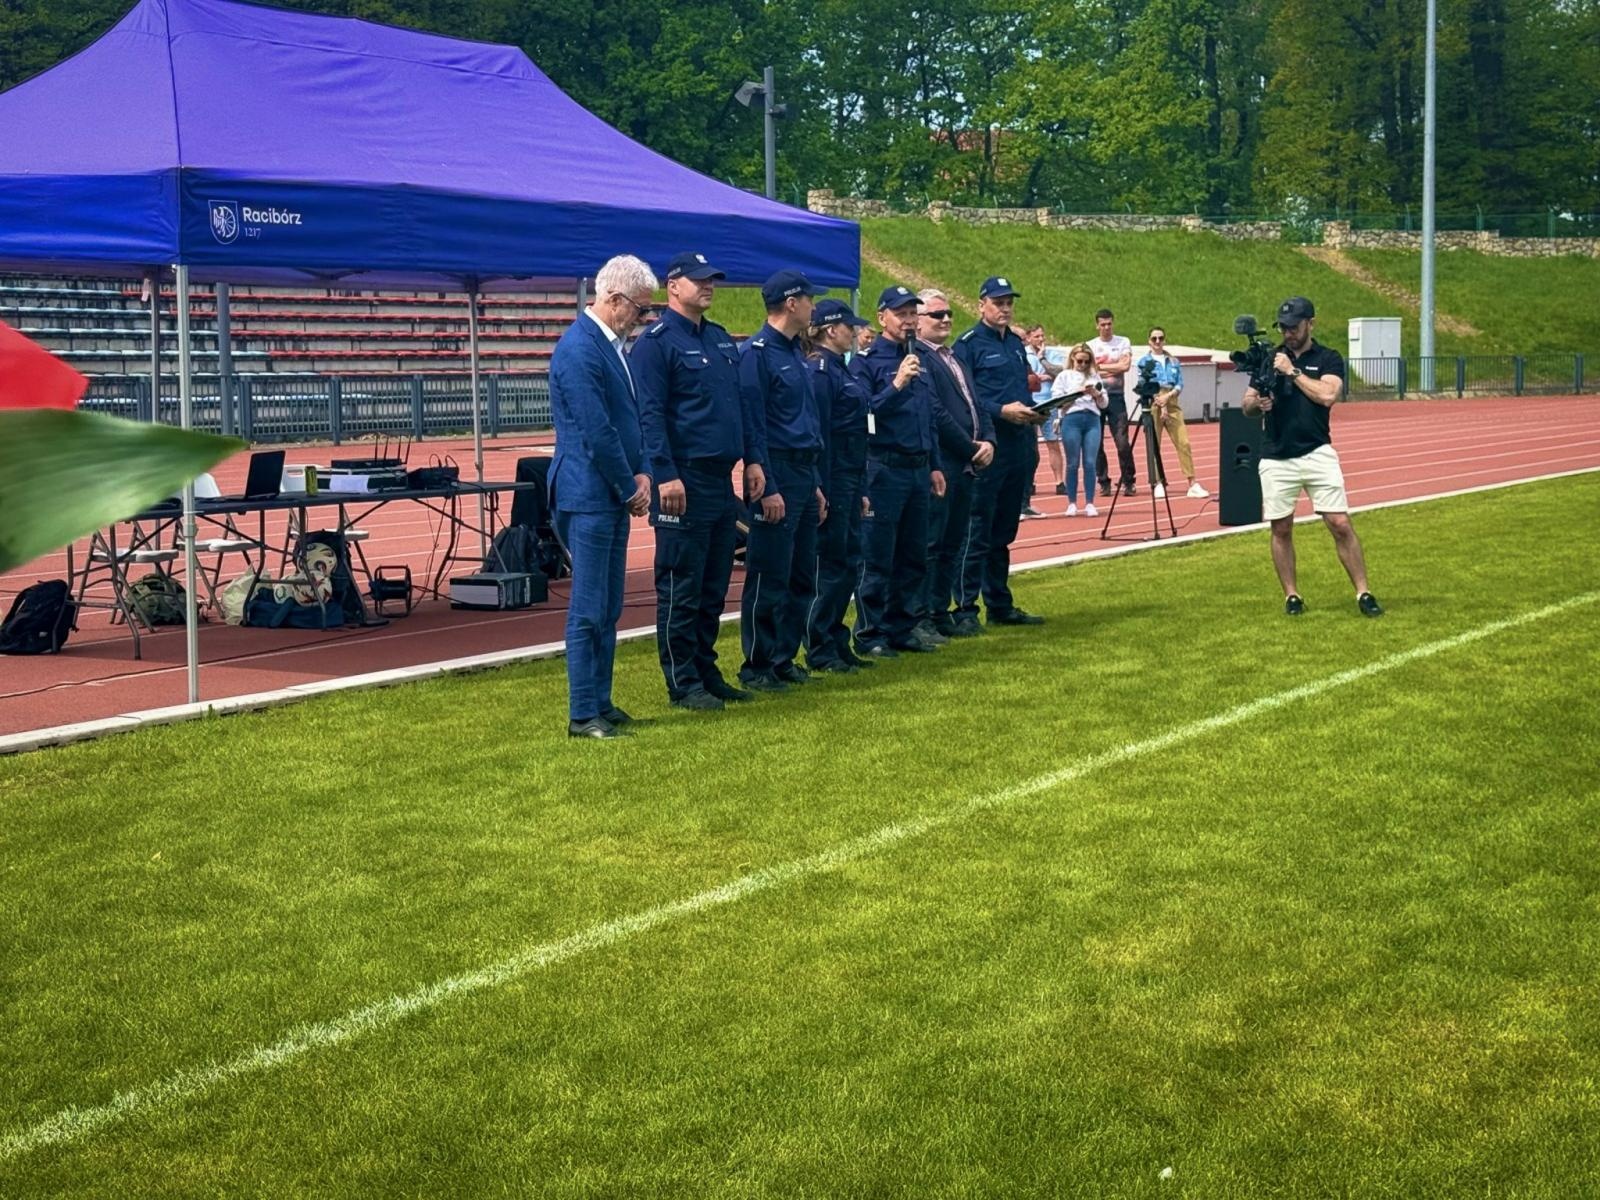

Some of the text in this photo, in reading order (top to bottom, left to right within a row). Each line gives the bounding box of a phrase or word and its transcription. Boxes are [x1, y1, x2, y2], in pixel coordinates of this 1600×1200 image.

[242, 206, 302, 225] Racibórz
[244, 227, 261, 239] 1217
[657, 514, 680, 523] POLICJA
